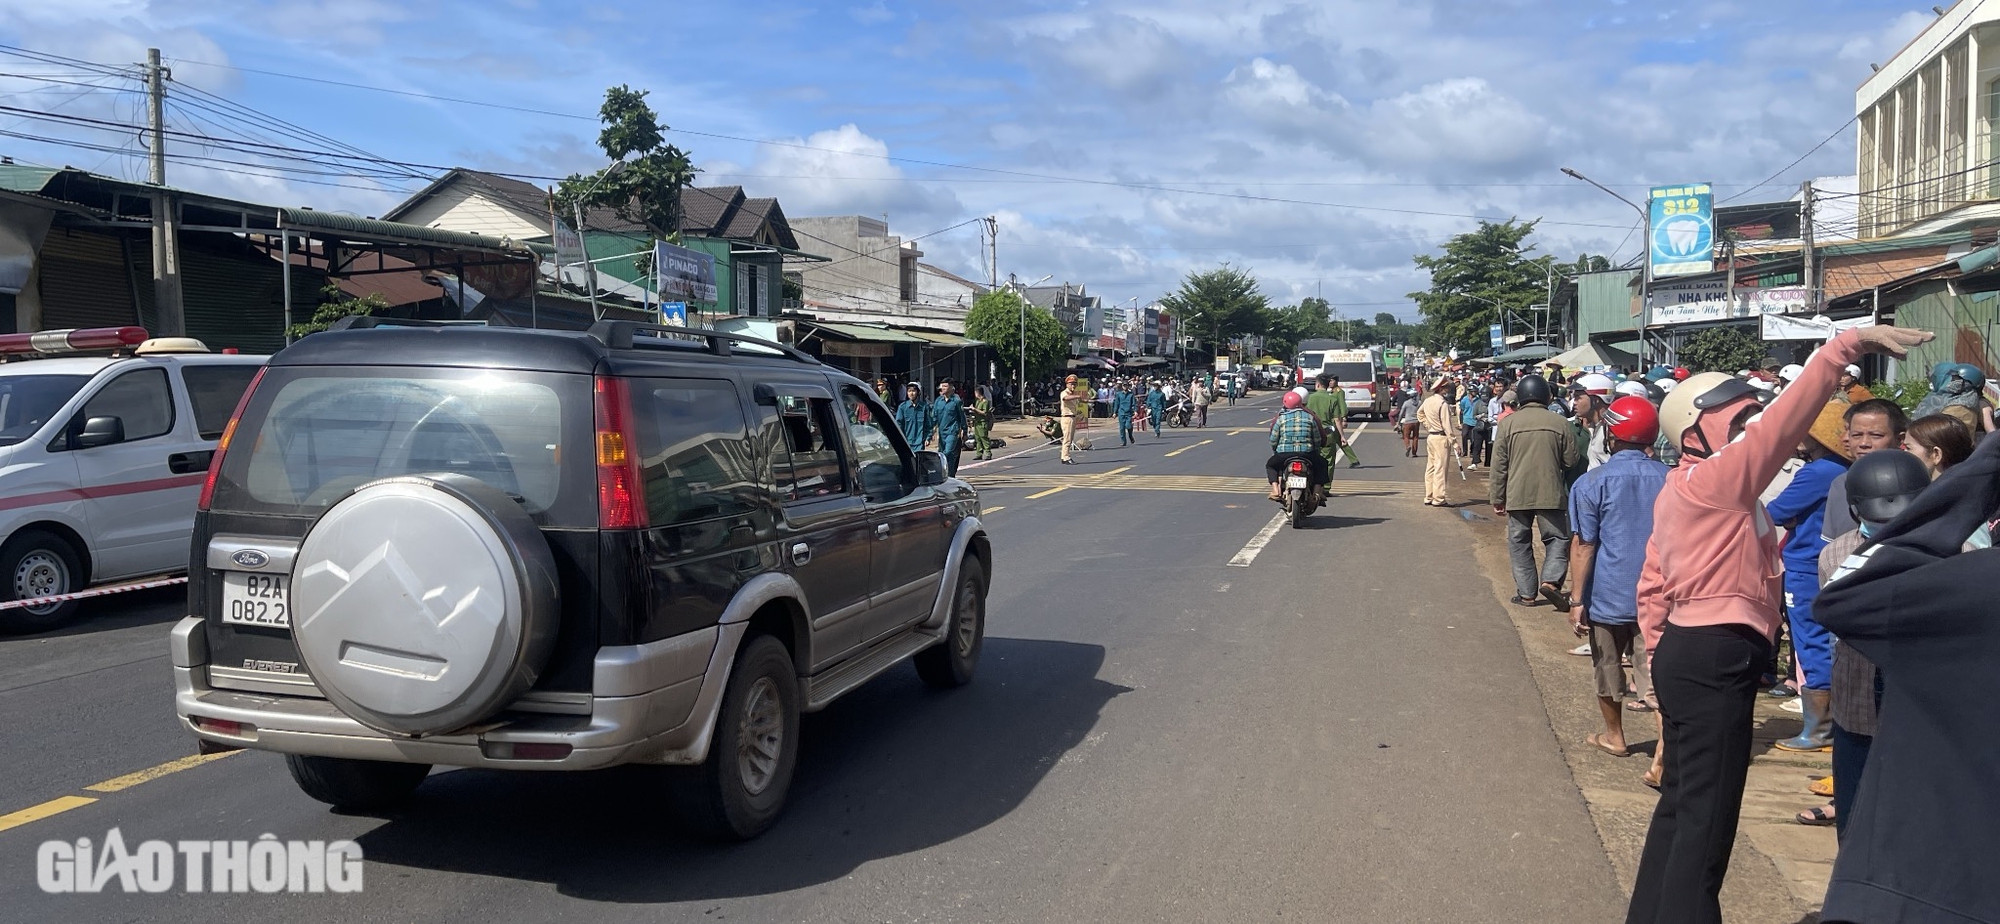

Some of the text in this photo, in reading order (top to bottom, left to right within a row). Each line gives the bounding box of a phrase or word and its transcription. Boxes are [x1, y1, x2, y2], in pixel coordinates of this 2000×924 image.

[1663, 198, 1699, 216] 312
[669, 258, 698, 275] PINACO
[238, 553, 259, 565] Ford
[247, 575, 283, 599] 82A
[231, 599, 290, 625] 082.2
[242, 659, 298, 673] EVEREST
